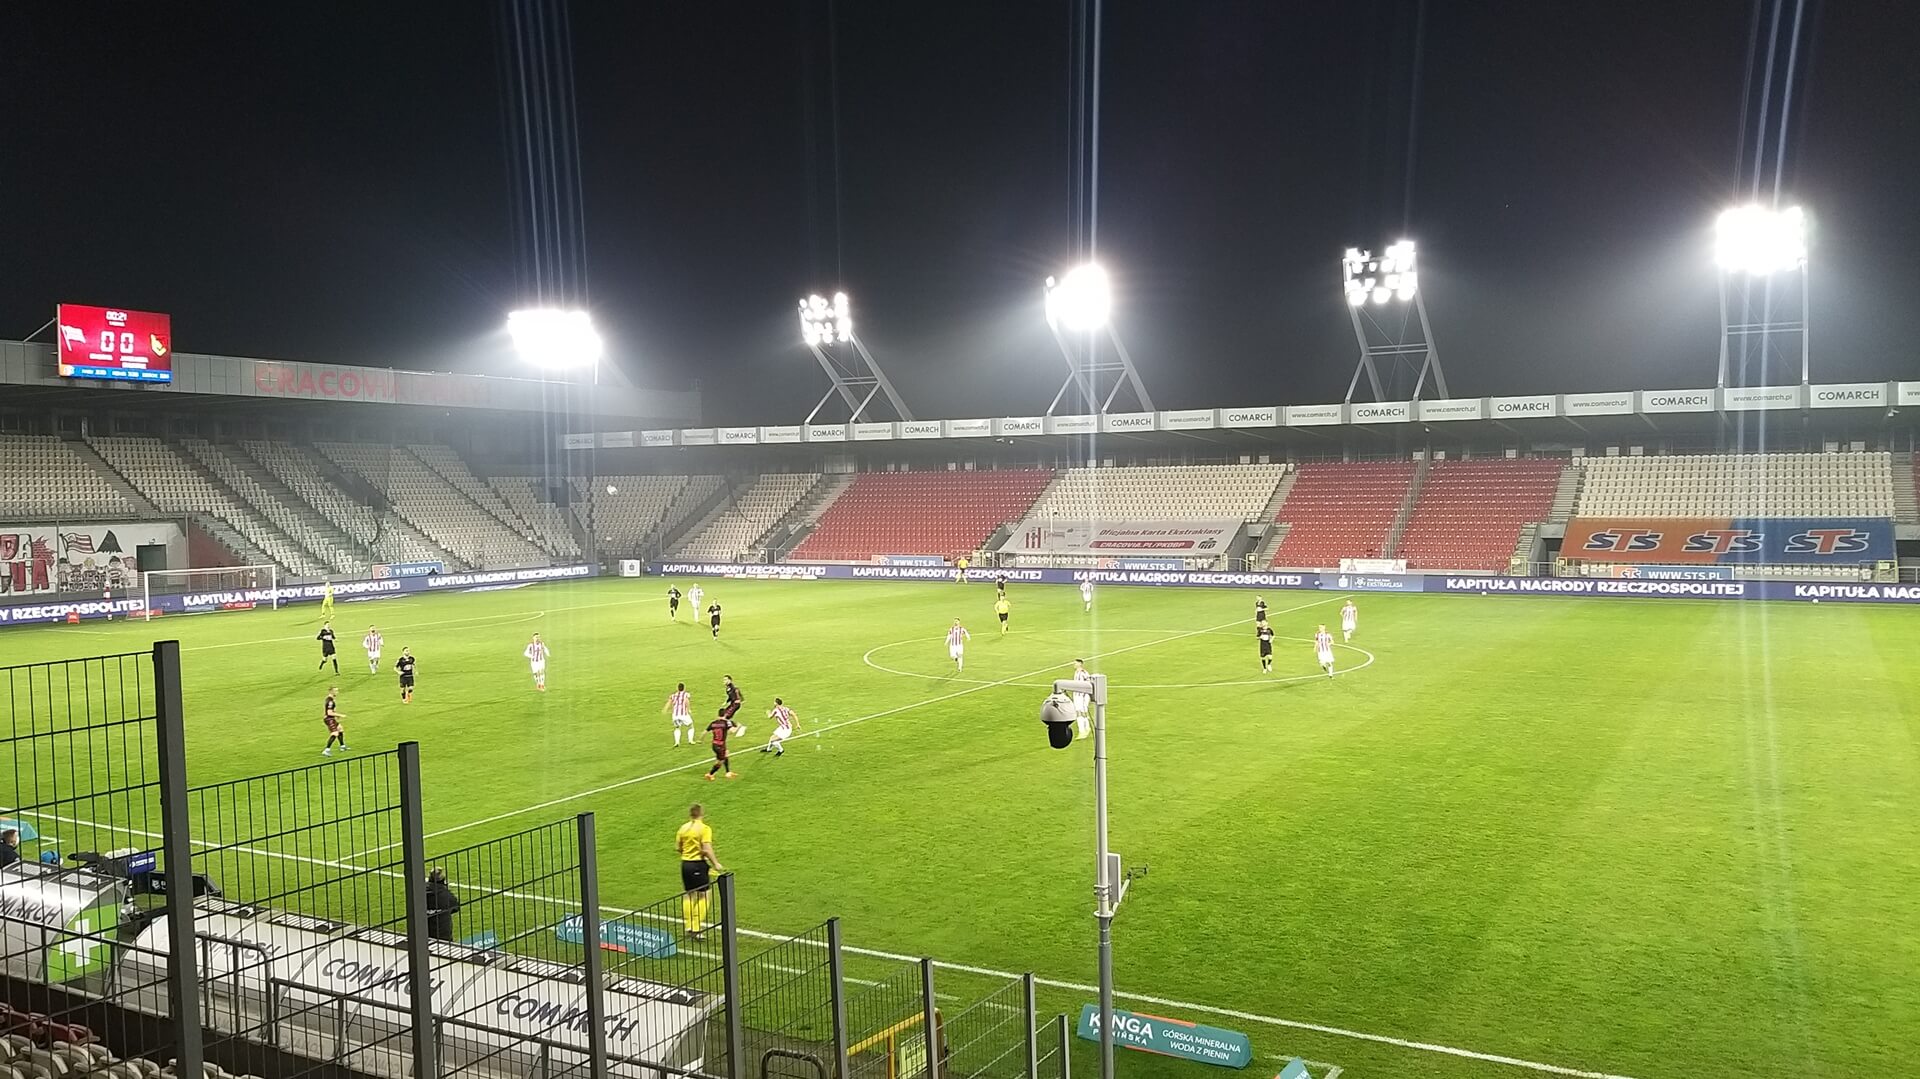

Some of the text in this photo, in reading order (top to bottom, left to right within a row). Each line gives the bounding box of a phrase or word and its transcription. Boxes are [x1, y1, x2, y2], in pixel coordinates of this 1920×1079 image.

[101, 331, 134, 354] 0 0
[1650, 396, 1708, 406] COMARCH
[1733, 394, 1793, 402] www.comarch.pl
[1817, 390, 1880, 401] COMARCH
[1426, 405, 1476, 414] www.comarch.pl
[1497, 402, 1550, 412] COMARCH
[1572, 400, 1628, 409] www.comarch.pl
[1228, 413, 1273, 422] COMARCH
[1356, 407, 1405, 417] COMARCH
[1003, 422, 1041, 431] COMARCH
[1111, 418, 1152, 427] COMARCH
[812, 429, 845, 437] COMARCH
[904, 426, 939, 434] COMARCH
[1167, 528, 1225, 536] Ekstraklasy
[1583, 528, 1870, 555] STS STS STS
[662, 564, 826, 576] KAPITUŁA NAGRODY RZECZPOSPOLITEJ
[853, 567, 898, 577] KAPITUŁA
[900, 568, 947, 578] NAGRODY
[1648, 571, 1723, 580] WWW.STS.PL
[428, 575, 474, 587] KAPITUŁA
[474, 572, 517, 583] NAGRODY
[1073, 571, 1301, 586] KAPITUŁA NAGRODY RZECZPOSPOLITEJ
[1446, 578, 1744, 595] KAPITUŁA NAGRODY RZECZPOSPOLITEJ
[1795, 585, 1880, 598] KAPITUŁA
[183, 591, 244, 606] KAPITUŁA
[12, 599, 144, 620] RZECZPOSPOLITEJ
[1089, 1012, 1153, 1039] KNGA
[1092, 1028, 1147, 1046] PNIŃSKA
[1162, 1027, 1241, 1053] GÓRSKA MINERALNA
[1170, 1041, 1230, 1060] WODA Z PIENIN
